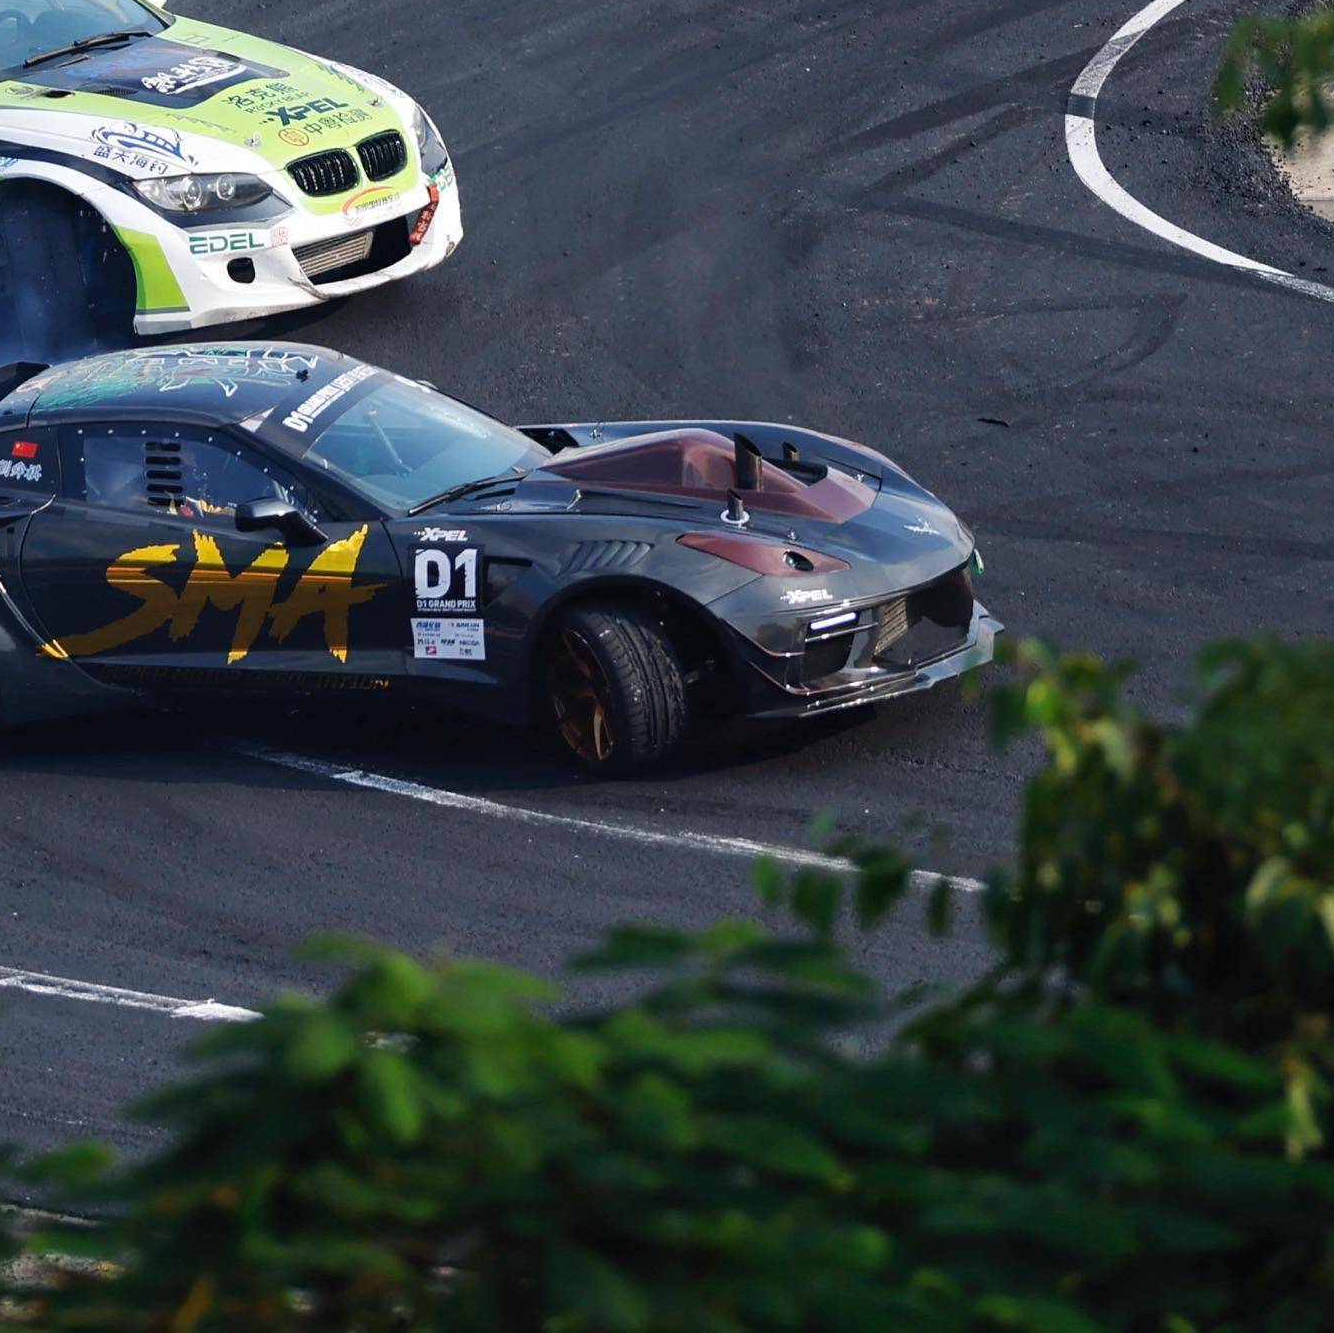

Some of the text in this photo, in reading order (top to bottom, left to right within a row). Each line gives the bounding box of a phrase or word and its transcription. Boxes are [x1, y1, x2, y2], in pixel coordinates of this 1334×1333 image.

[264, 97, 349, 127] XPEL
[189, 233, 265, 255] EDEL
[420, 527, 469, 542] XPEL
[414, 548, 478, 599] D1
[36, 523, 388, 665] SMA
[428, 599, 457, 609] GRAND
[457, 599, 476, 609] PRIX
[787, 588, 833, 605] XPEL
